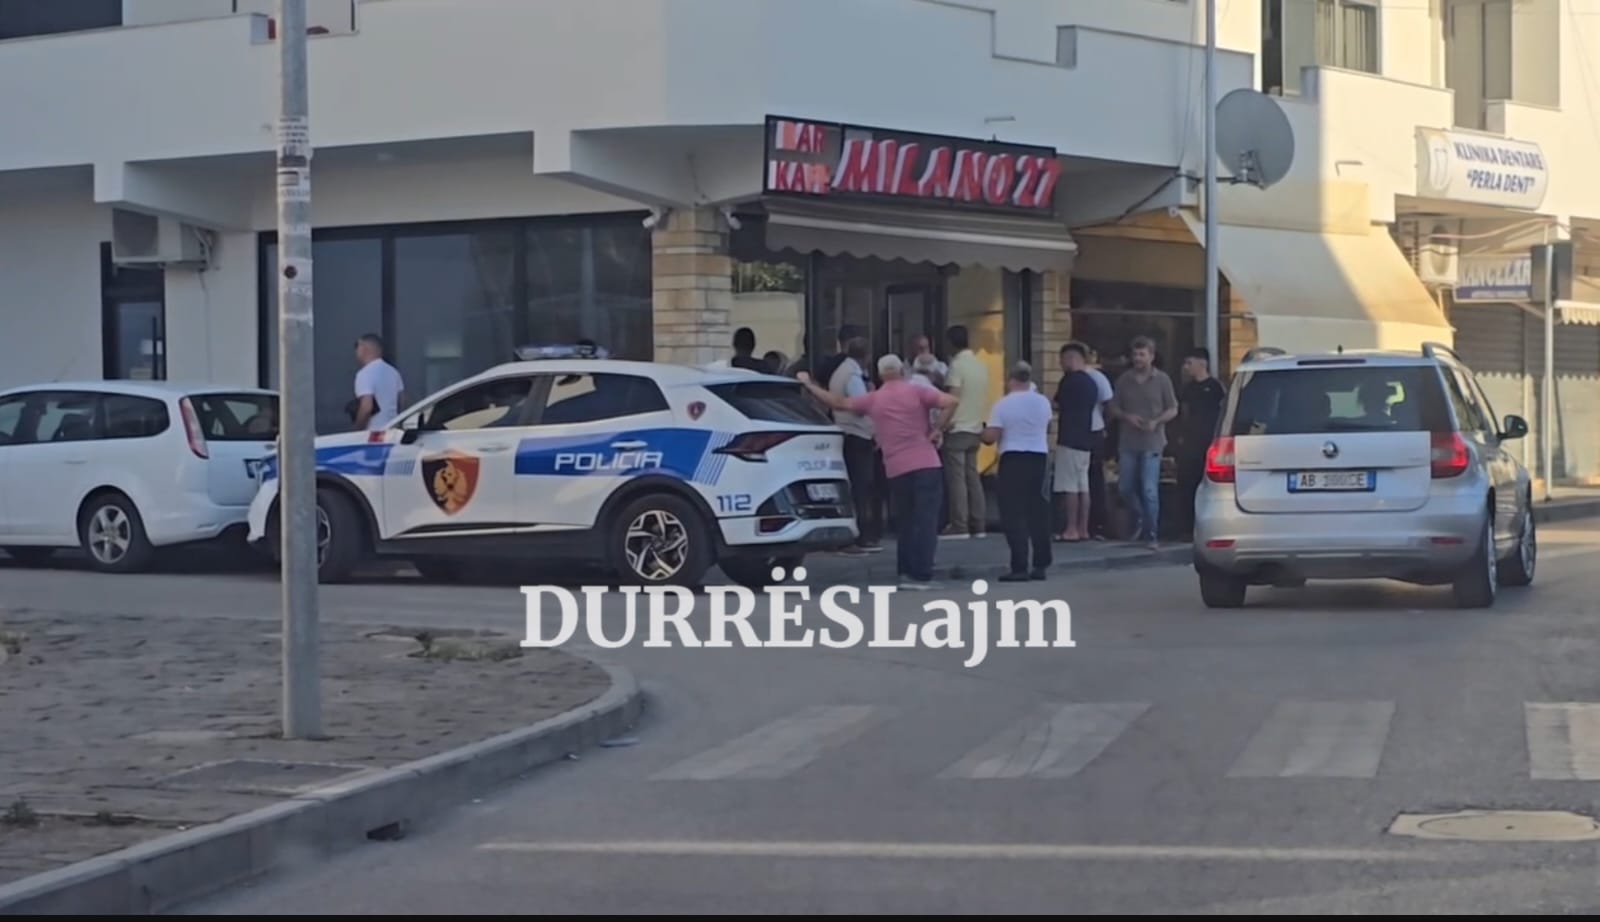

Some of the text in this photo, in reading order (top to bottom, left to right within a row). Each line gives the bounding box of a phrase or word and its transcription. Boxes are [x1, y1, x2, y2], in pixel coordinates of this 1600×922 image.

[775, 120, 825, 152] AR
[1454, 142, 1544, 170] KLINIKA DENTARE
[768, 160, 832, 194] KA
[554, 451, 664, 471] POLICIA
[1301, 474, 1316, 487] AB
[716, 494, 752, 513] 112
